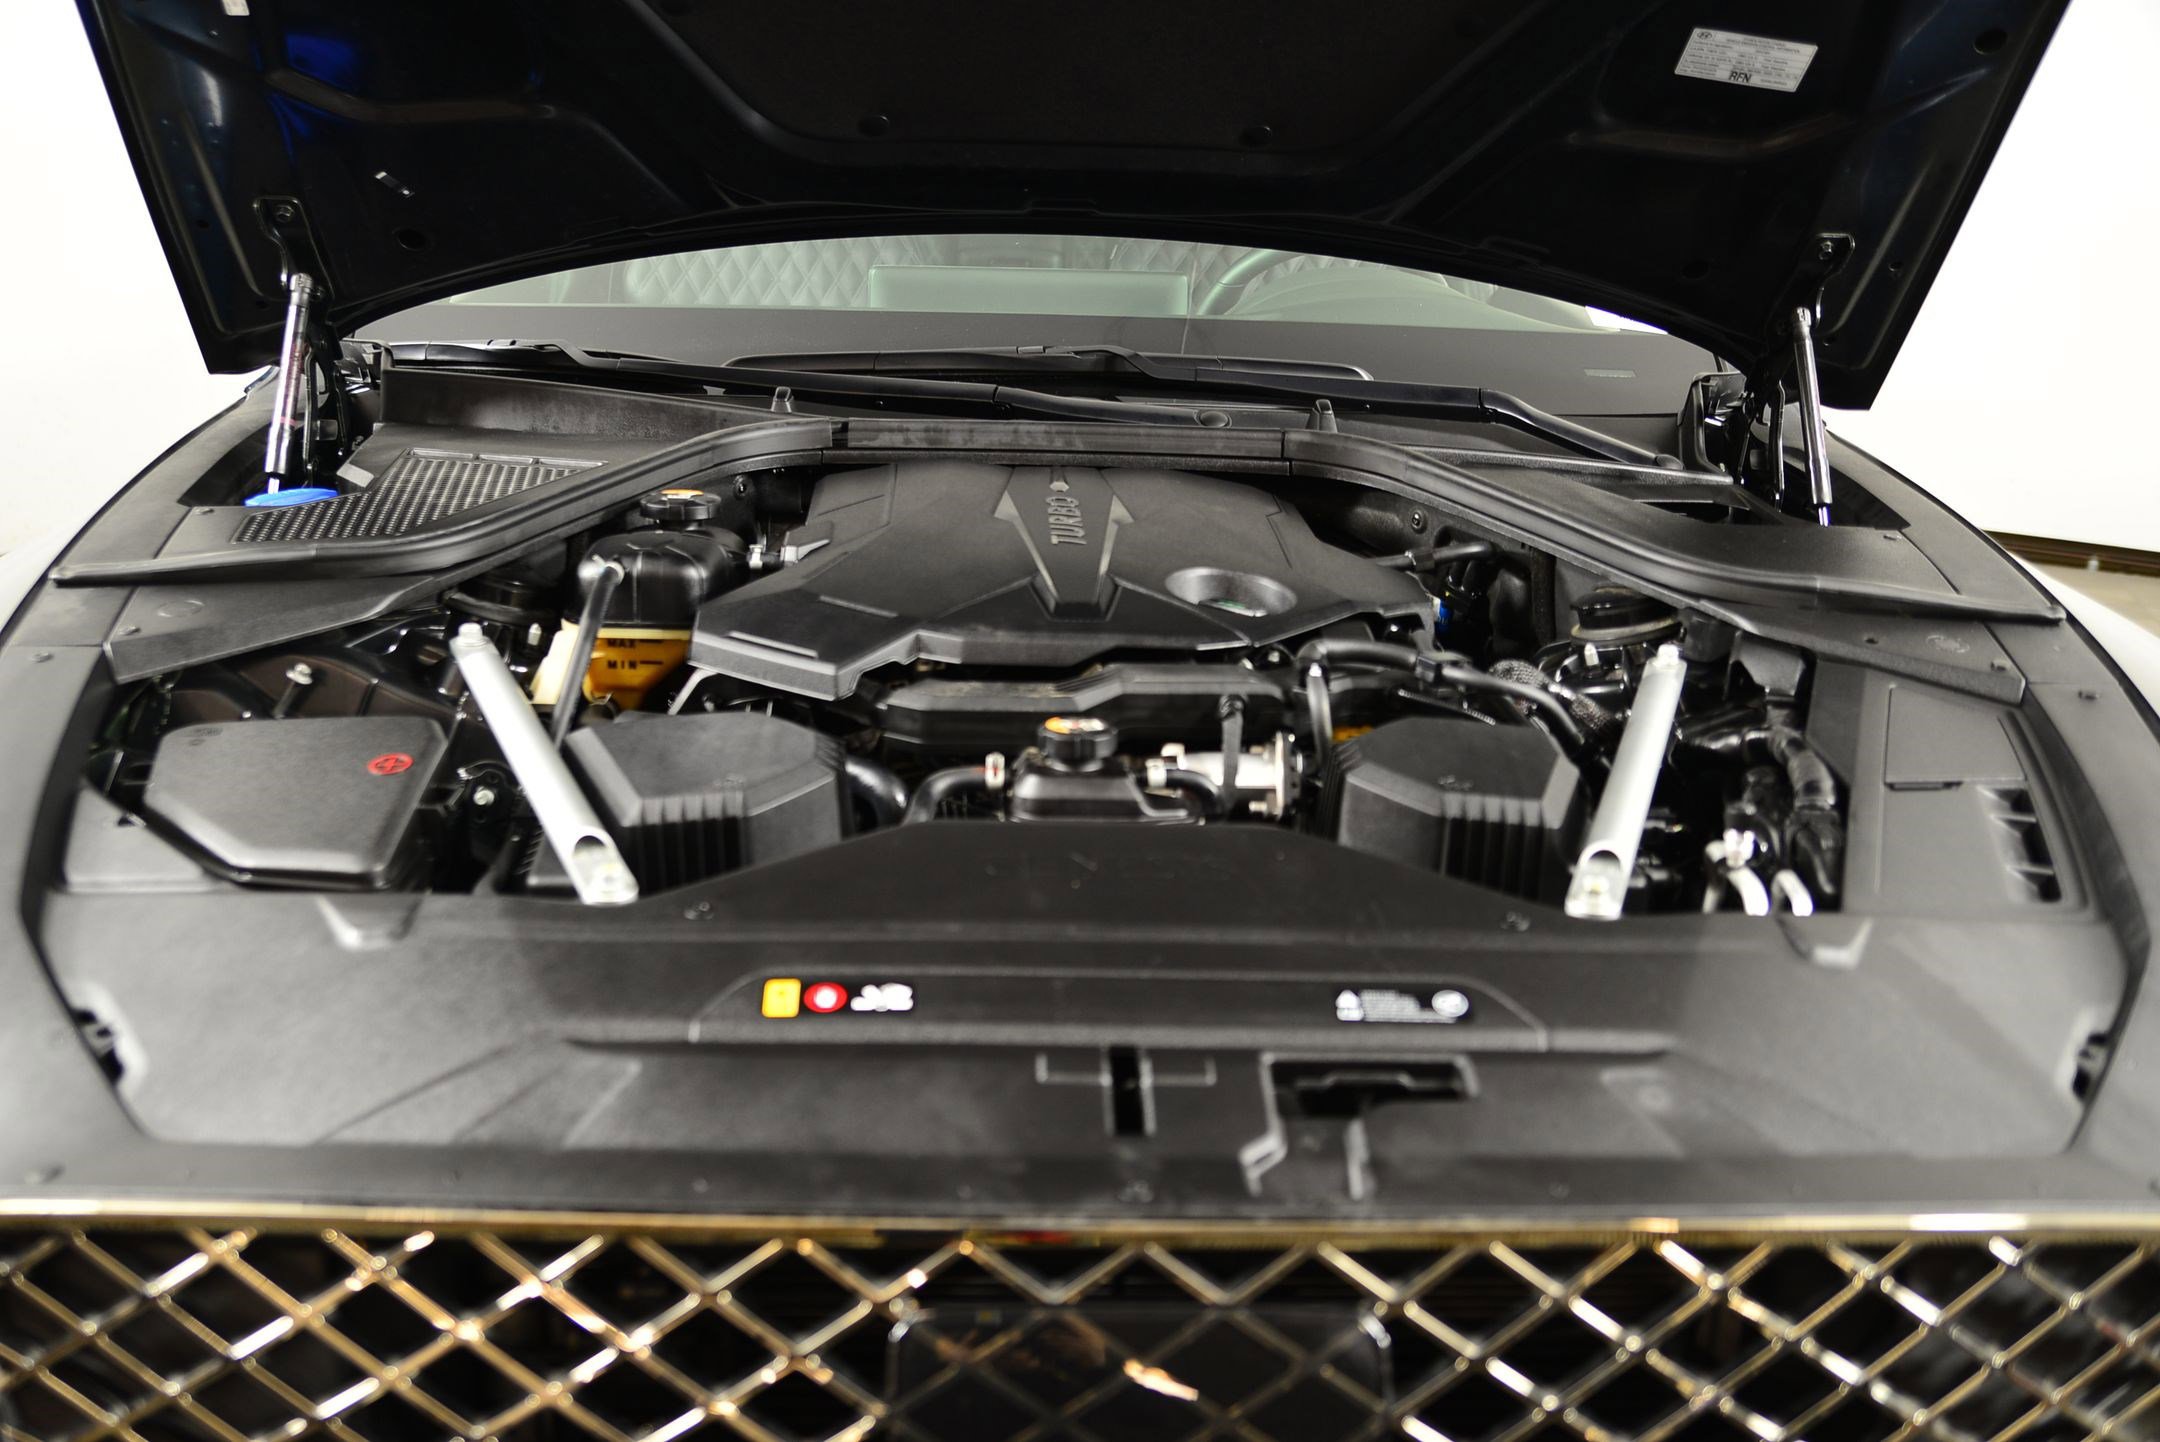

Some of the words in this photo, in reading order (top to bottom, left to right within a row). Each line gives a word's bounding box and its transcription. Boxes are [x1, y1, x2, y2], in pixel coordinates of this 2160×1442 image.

[1728, 70, 1752, 83] RFN
[1046, 496, 1087, 545] TURBO
[607, 639, 636, 648] MAX
[607, 660, 638, 670] MIN
